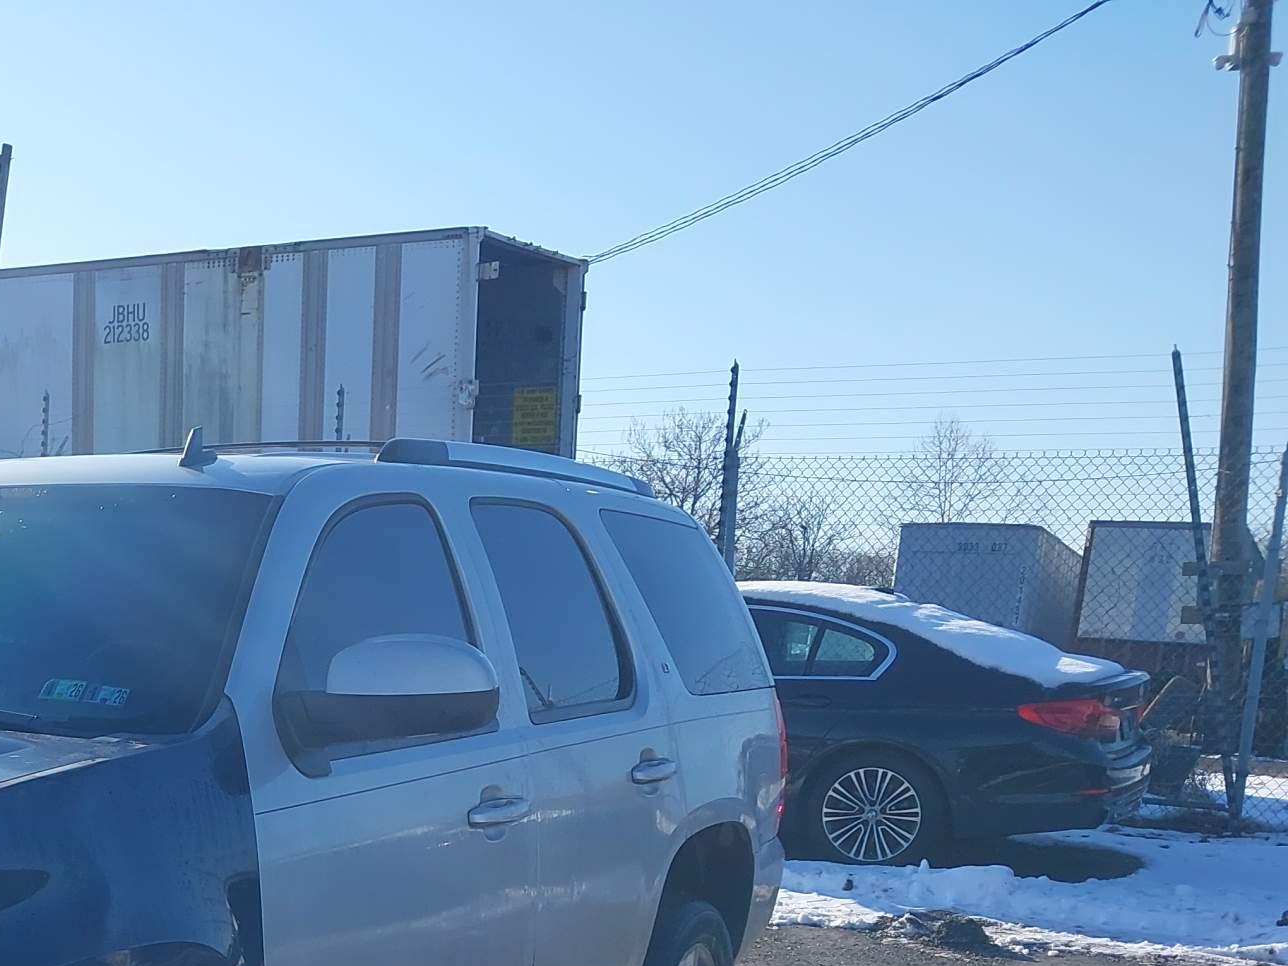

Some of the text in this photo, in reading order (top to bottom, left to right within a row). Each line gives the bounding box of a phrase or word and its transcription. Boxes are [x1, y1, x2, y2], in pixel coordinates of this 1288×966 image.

[108, 303, 146, 324] JBHU
[103, 321, 150, 344] 212338
[68, 682, 85, 698] 26
